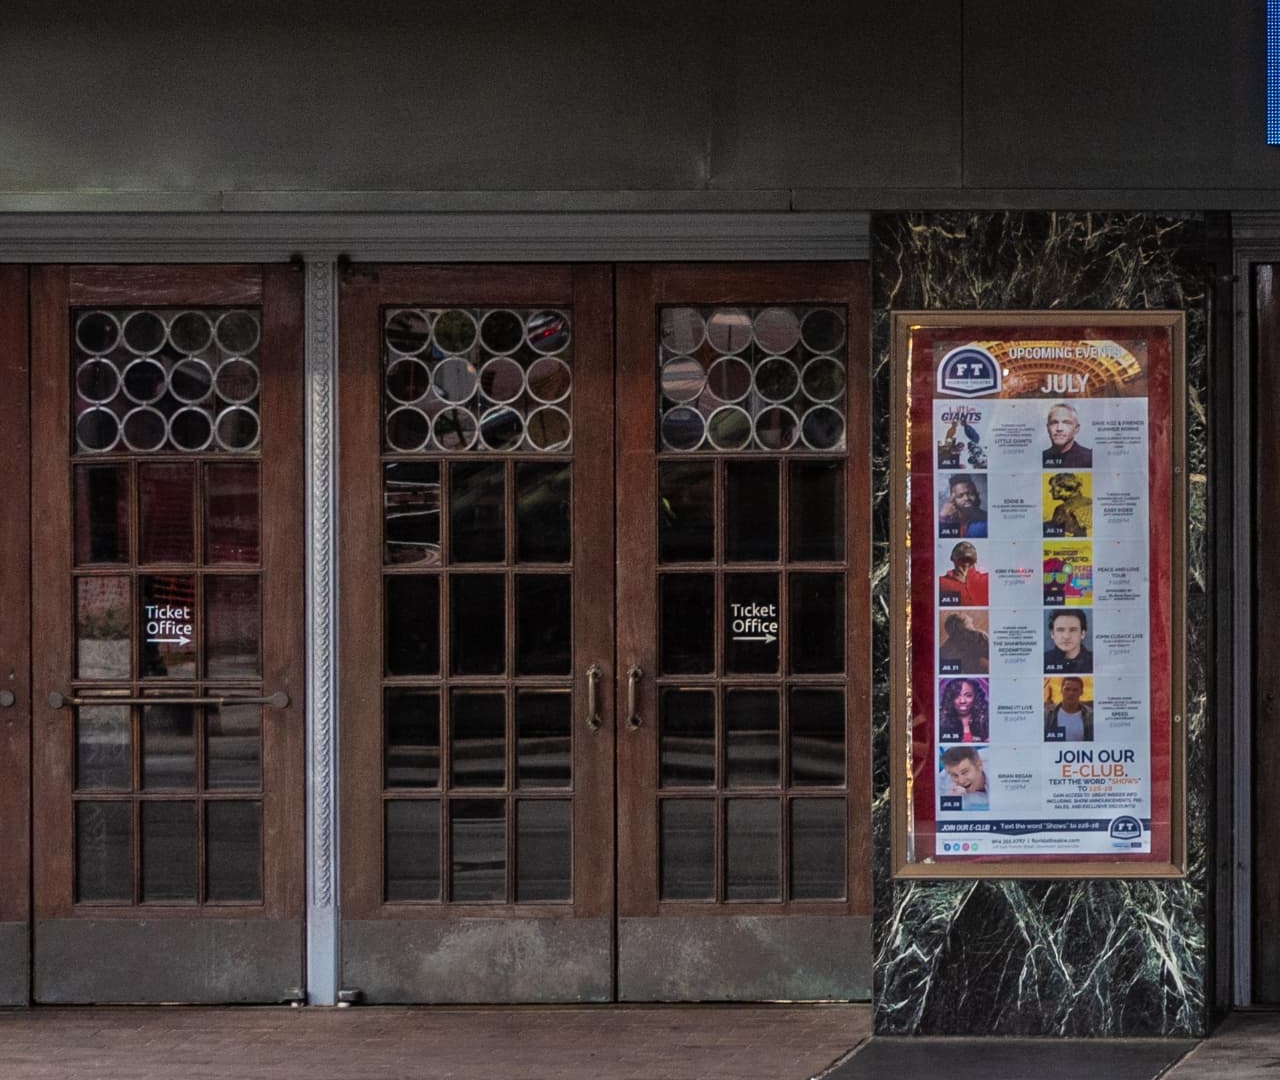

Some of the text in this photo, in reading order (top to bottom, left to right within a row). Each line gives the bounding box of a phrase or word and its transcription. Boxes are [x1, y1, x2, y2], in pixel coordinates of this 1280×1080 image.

[1008, 347, 1072, 359] UPCOMING
[1041, 374, 1090, 393] JULY
[941, 412, 982, 422] GIANTS
[145, 605, 191, 620] Ticket
[730, 602, 776, 617] Ticket
[146, 621, 192, 635] Office
[732, 618, 778, 633] Office
[1054, 749, 1135, 764] JOIN OUR
[1062, 764, 1128, 778] E-CLUB.
